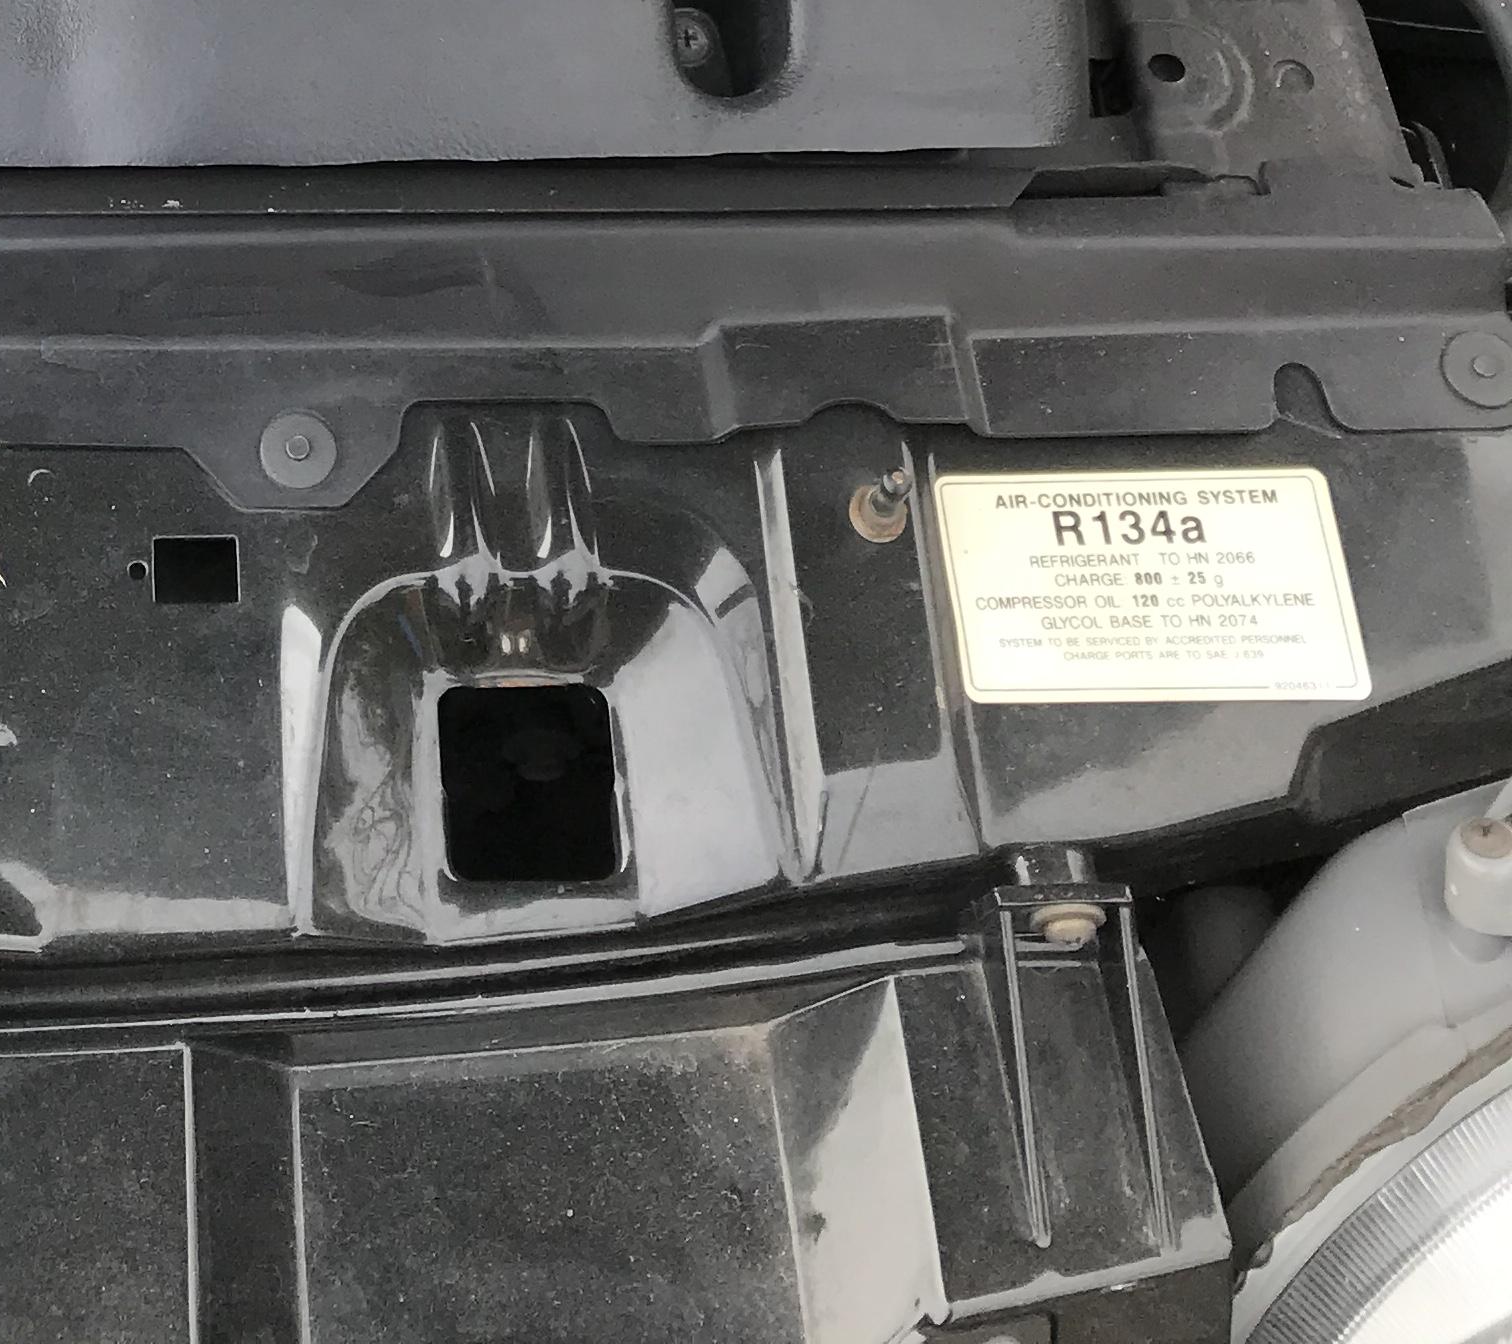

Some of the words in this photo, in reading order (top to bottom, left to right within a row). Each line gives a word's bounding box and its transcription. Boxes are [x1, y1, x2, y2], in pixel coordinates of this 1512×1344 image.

[993, 491, 1188, 509] AIR-CONDITIONING
[1196, 489, 1278, 505] SYSTEM
[1051, 508, 1207, 546] R134a
[1028, 553, 1141, 567] REFRIGERANT
[1158, 552, 1181, 565] TO
[1186, 552, 1210, 565] HN
[1215, 551, 1256, 564] 2066
[1134, 572, 1163, 585] 800
[1187, 571, 1206, 584] 25
[1213, 574, 1224, 587] g
[975, 595, 1087, 610] COMPRESSOR
[1093, 594, 1120, 608] OIL
[1132, 594, 1159, 607] 120
[1165, 597, 1185, 607] cc
[1191, 592, 1315, 607] POLYALKYLENE
[1040, 615, 1102, 629] GLYCOL
[1109, 614, 1152, 628] BASE
[1160, 614, 1183, 627] TO
[1188, 614, 1211, 627] HN
[1217, 613, 1258, 626] 2074
[998, 637, 1042, 647] SYSTEM
[1048, 637, 1062, 646] TO
[1066, 637, 1080, 646] BE
[1085, 636, 1140, 646] SERVICED
[1145, 636, 1158, 645] BY
[1165, 635, 1236, 645] ACCREDITED
[1240, 634, 1306, 644] PERSONNEL
